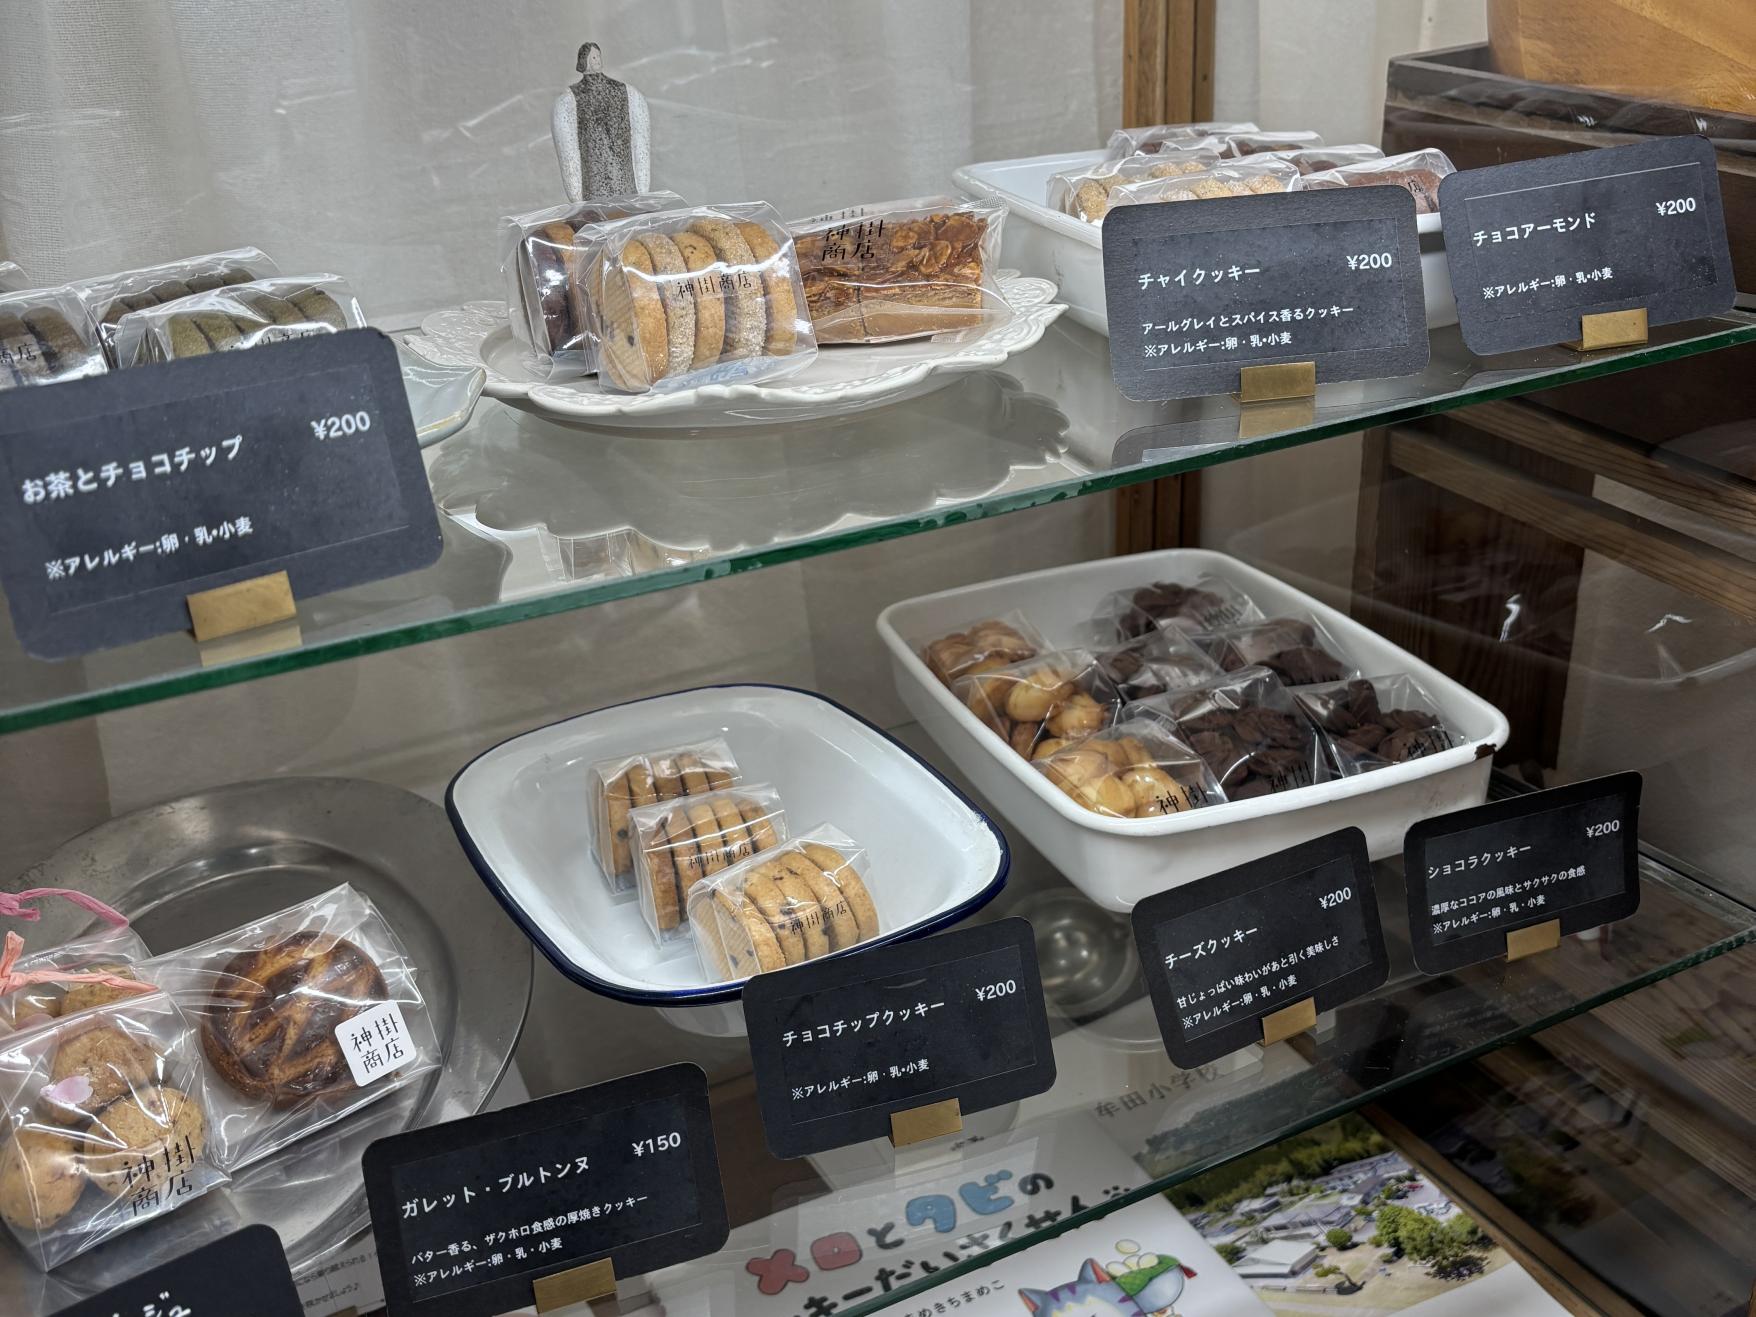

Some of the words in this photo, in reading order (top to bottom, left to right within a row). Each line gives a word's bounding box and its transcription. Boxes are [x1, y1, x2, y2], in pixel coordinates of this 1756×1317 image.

[1655, 197, 1696, 217] ¥200
[1472, 212, 1596, 247] チョコアーモンド
[1138, 265, 1260, 290] チャイクッキー
[1345, 252, 1393, 270] ¥200
[1141, 305, 1354, 335] アールグレイとスパイス香るクッキー
[310, 411, 371, 440] ¥200
[22, 434, 243, 503] お茶とチョコチップ
[1586, 819, 1620, 838] ¥200
[1428, 846, 1531, 879] ショコラクッキー
[1318, 886, 1352, 909] ¥200
[1431, 865, 1586, 916] 濃厚なココアの風味とサクサクの食感
[1164, 927, 1258, 970] チーズクッキー
[1176, 935, 1339, 1009] 甘じょっぱい味わいがあと引く美味しさ
[975, 979, 1017, 1002] ¥200
[782, 1002, 945, 1047] チョコチップクッキー
[361, 1037, 405, 1075] 商店
[631, 1132, 681, 1157] ¥150
[401, 1156, 589, 1219] ガレット・ブルトンヌ
[411, 1196, 648, 1265] バター香る、ザクホロ食感の厚焼きクッキー
